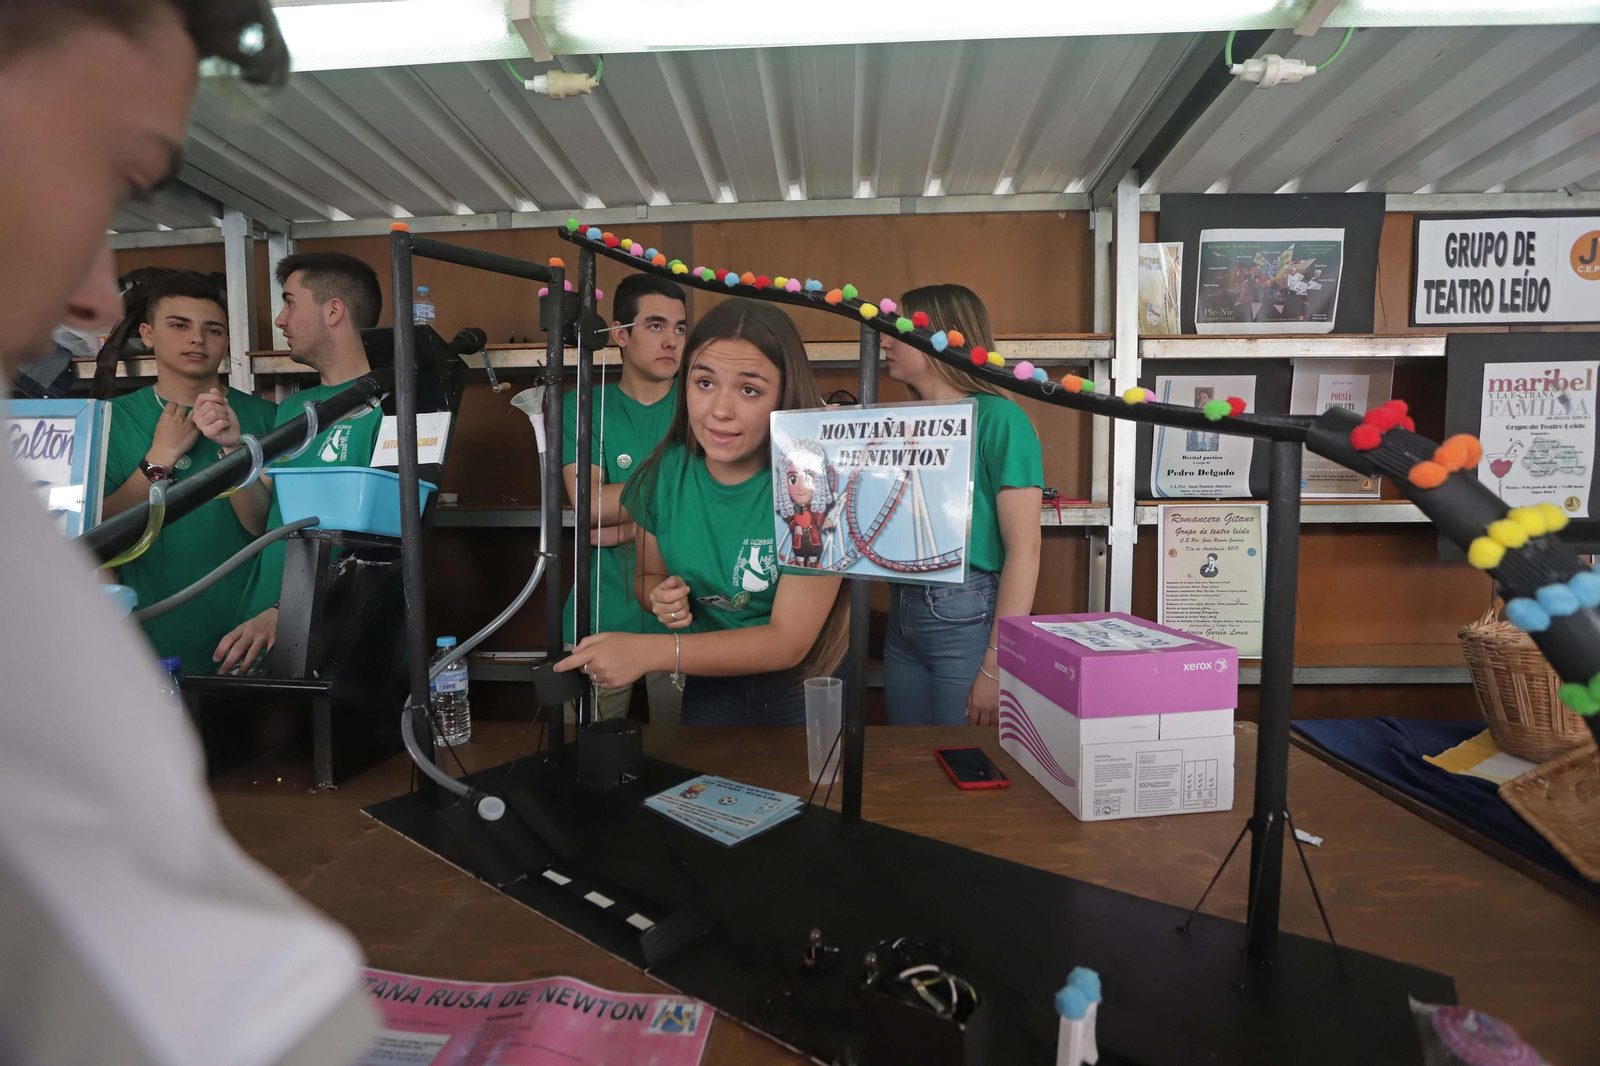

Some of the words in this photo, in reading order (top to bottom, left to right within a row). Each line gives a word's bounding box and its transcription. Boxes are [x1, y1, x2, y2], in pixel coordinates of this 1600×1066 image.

[1445, 231, 1509, 268] GRUPO
[1513, 231, 1536, 267] DE
[1424, 278, 1494, 314] TEATRO
[1499, 269, 1550, 313] LEÍDO
[1204, 308, 1235, 316] Pic-Nic
[1488, 369, 1592, 392] maribel
[1331, 391, 1351, 400] POESÍA
[1487, 398, 1591, 417] FAMILIA
[820, 418, 905, 440] MONTAÑA
[912, 419, 967, 436] RUSA
[838, 450, 860, 467] DE
[865, 449, 949, 466] NEWTON
[1198, 469, 1234, 477] Delgado
[1170, 514, 1220, 524] Romancero
[1224, 513, 1254, 525] Gitano
[1175, 527, 1197, 537] Grupo
[1054, 660, 1068, 674] xerox
[1183, 661, 1212, 671] xerox
[364, 977, 423, 1004] TAÑA
[425, 988, 494, 1008] RUSA
[497, 986, 537, 1007] DE
[536, 985, 649, 1020] NEWTON
